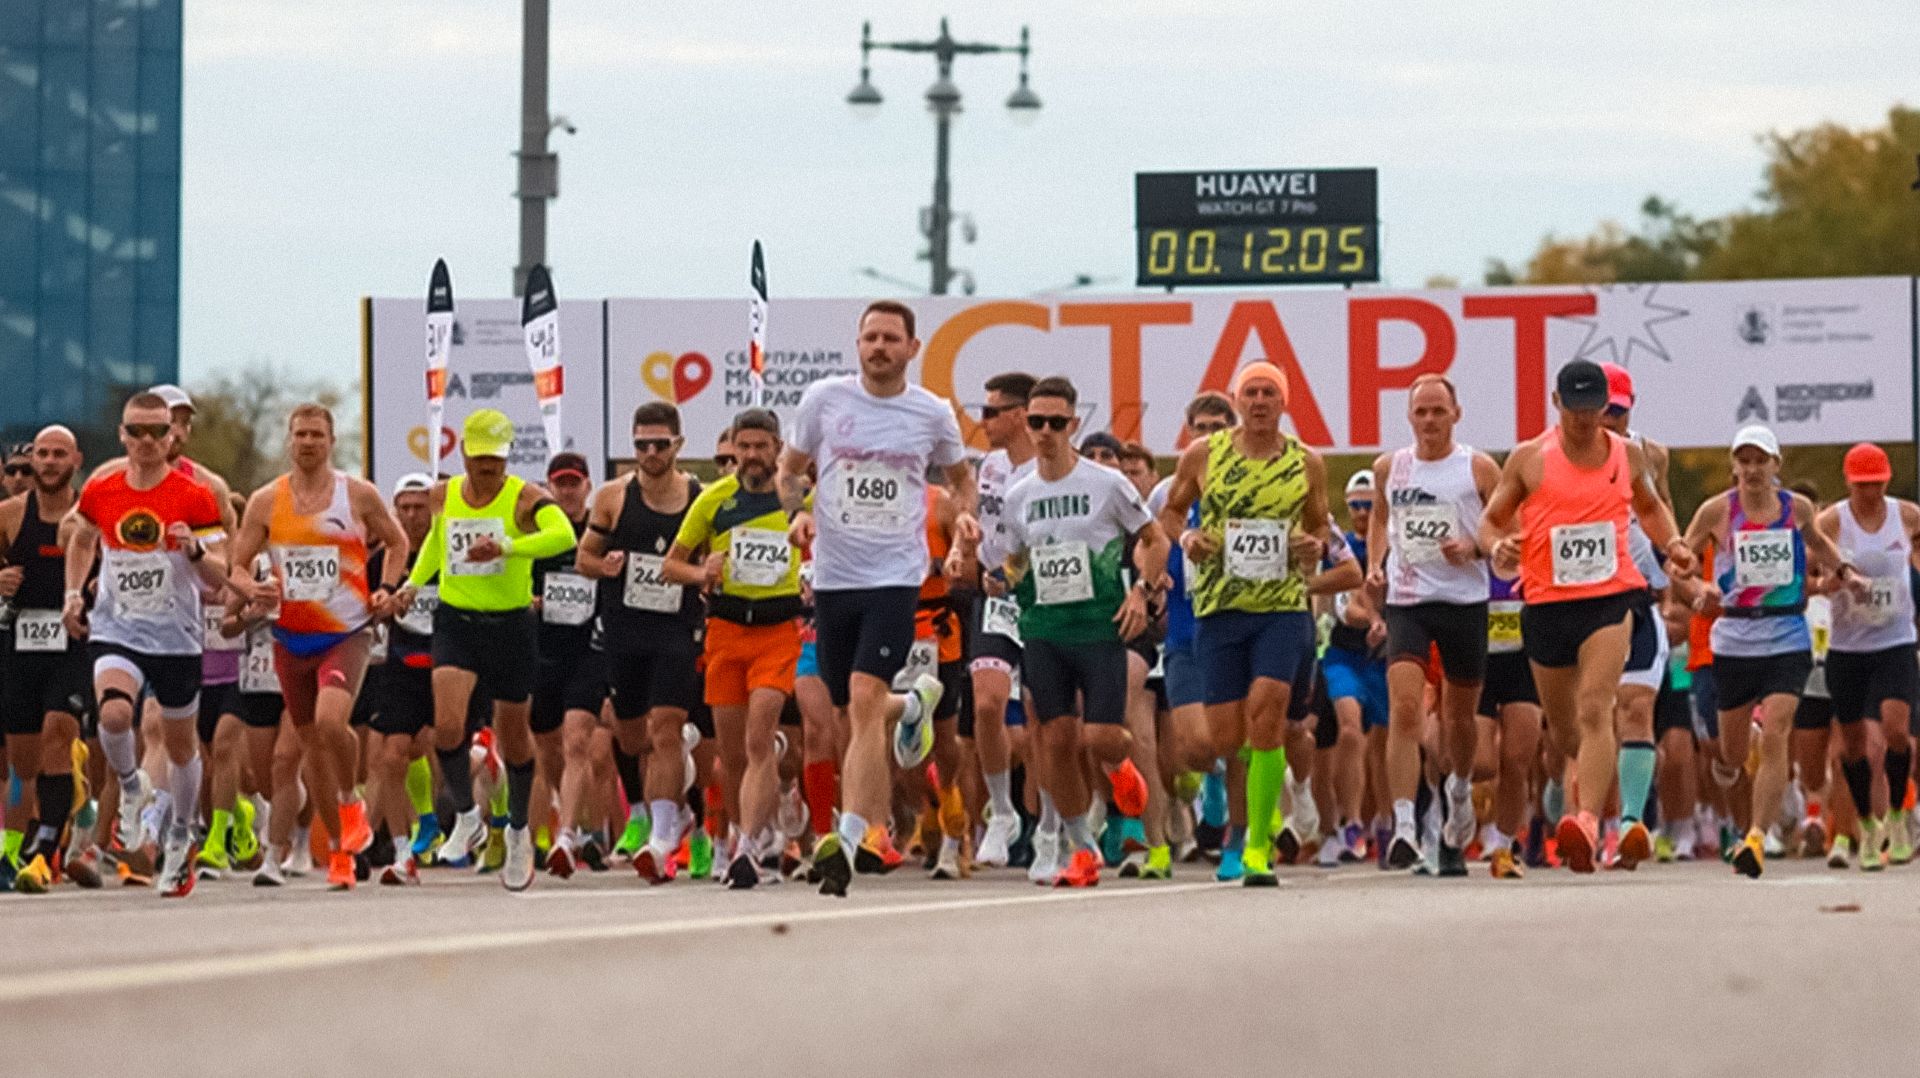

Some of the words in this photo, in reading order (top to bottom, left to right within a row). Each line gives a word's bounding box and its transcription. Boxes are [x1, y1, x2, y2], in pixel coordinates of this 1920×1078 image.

[1196, 173, 1317, 196] HUAWEI
[725, 350, 843, 365] СБРПРАЙМ
[919, 293, 1597, 449] СТАРТ
[847, 477, 898, 501] 1680
[1405, 520, 1451, 540] 5422
[451, 532, 494, 552] 31
[734, 541, 789, 564] 12734
[1233, 533, 1281, 554] 4731
[1560, 537, 1606, 560] 6791
[1739, 543, 1792, 563] 15356
[285, 559, 337, 578] 12510
[634, 567, 669, 587] 244
[1039, 556, 1082, 579] 4023
[117, 568, 164, 592] 2087
[21, 621, 61, 640] 1267
